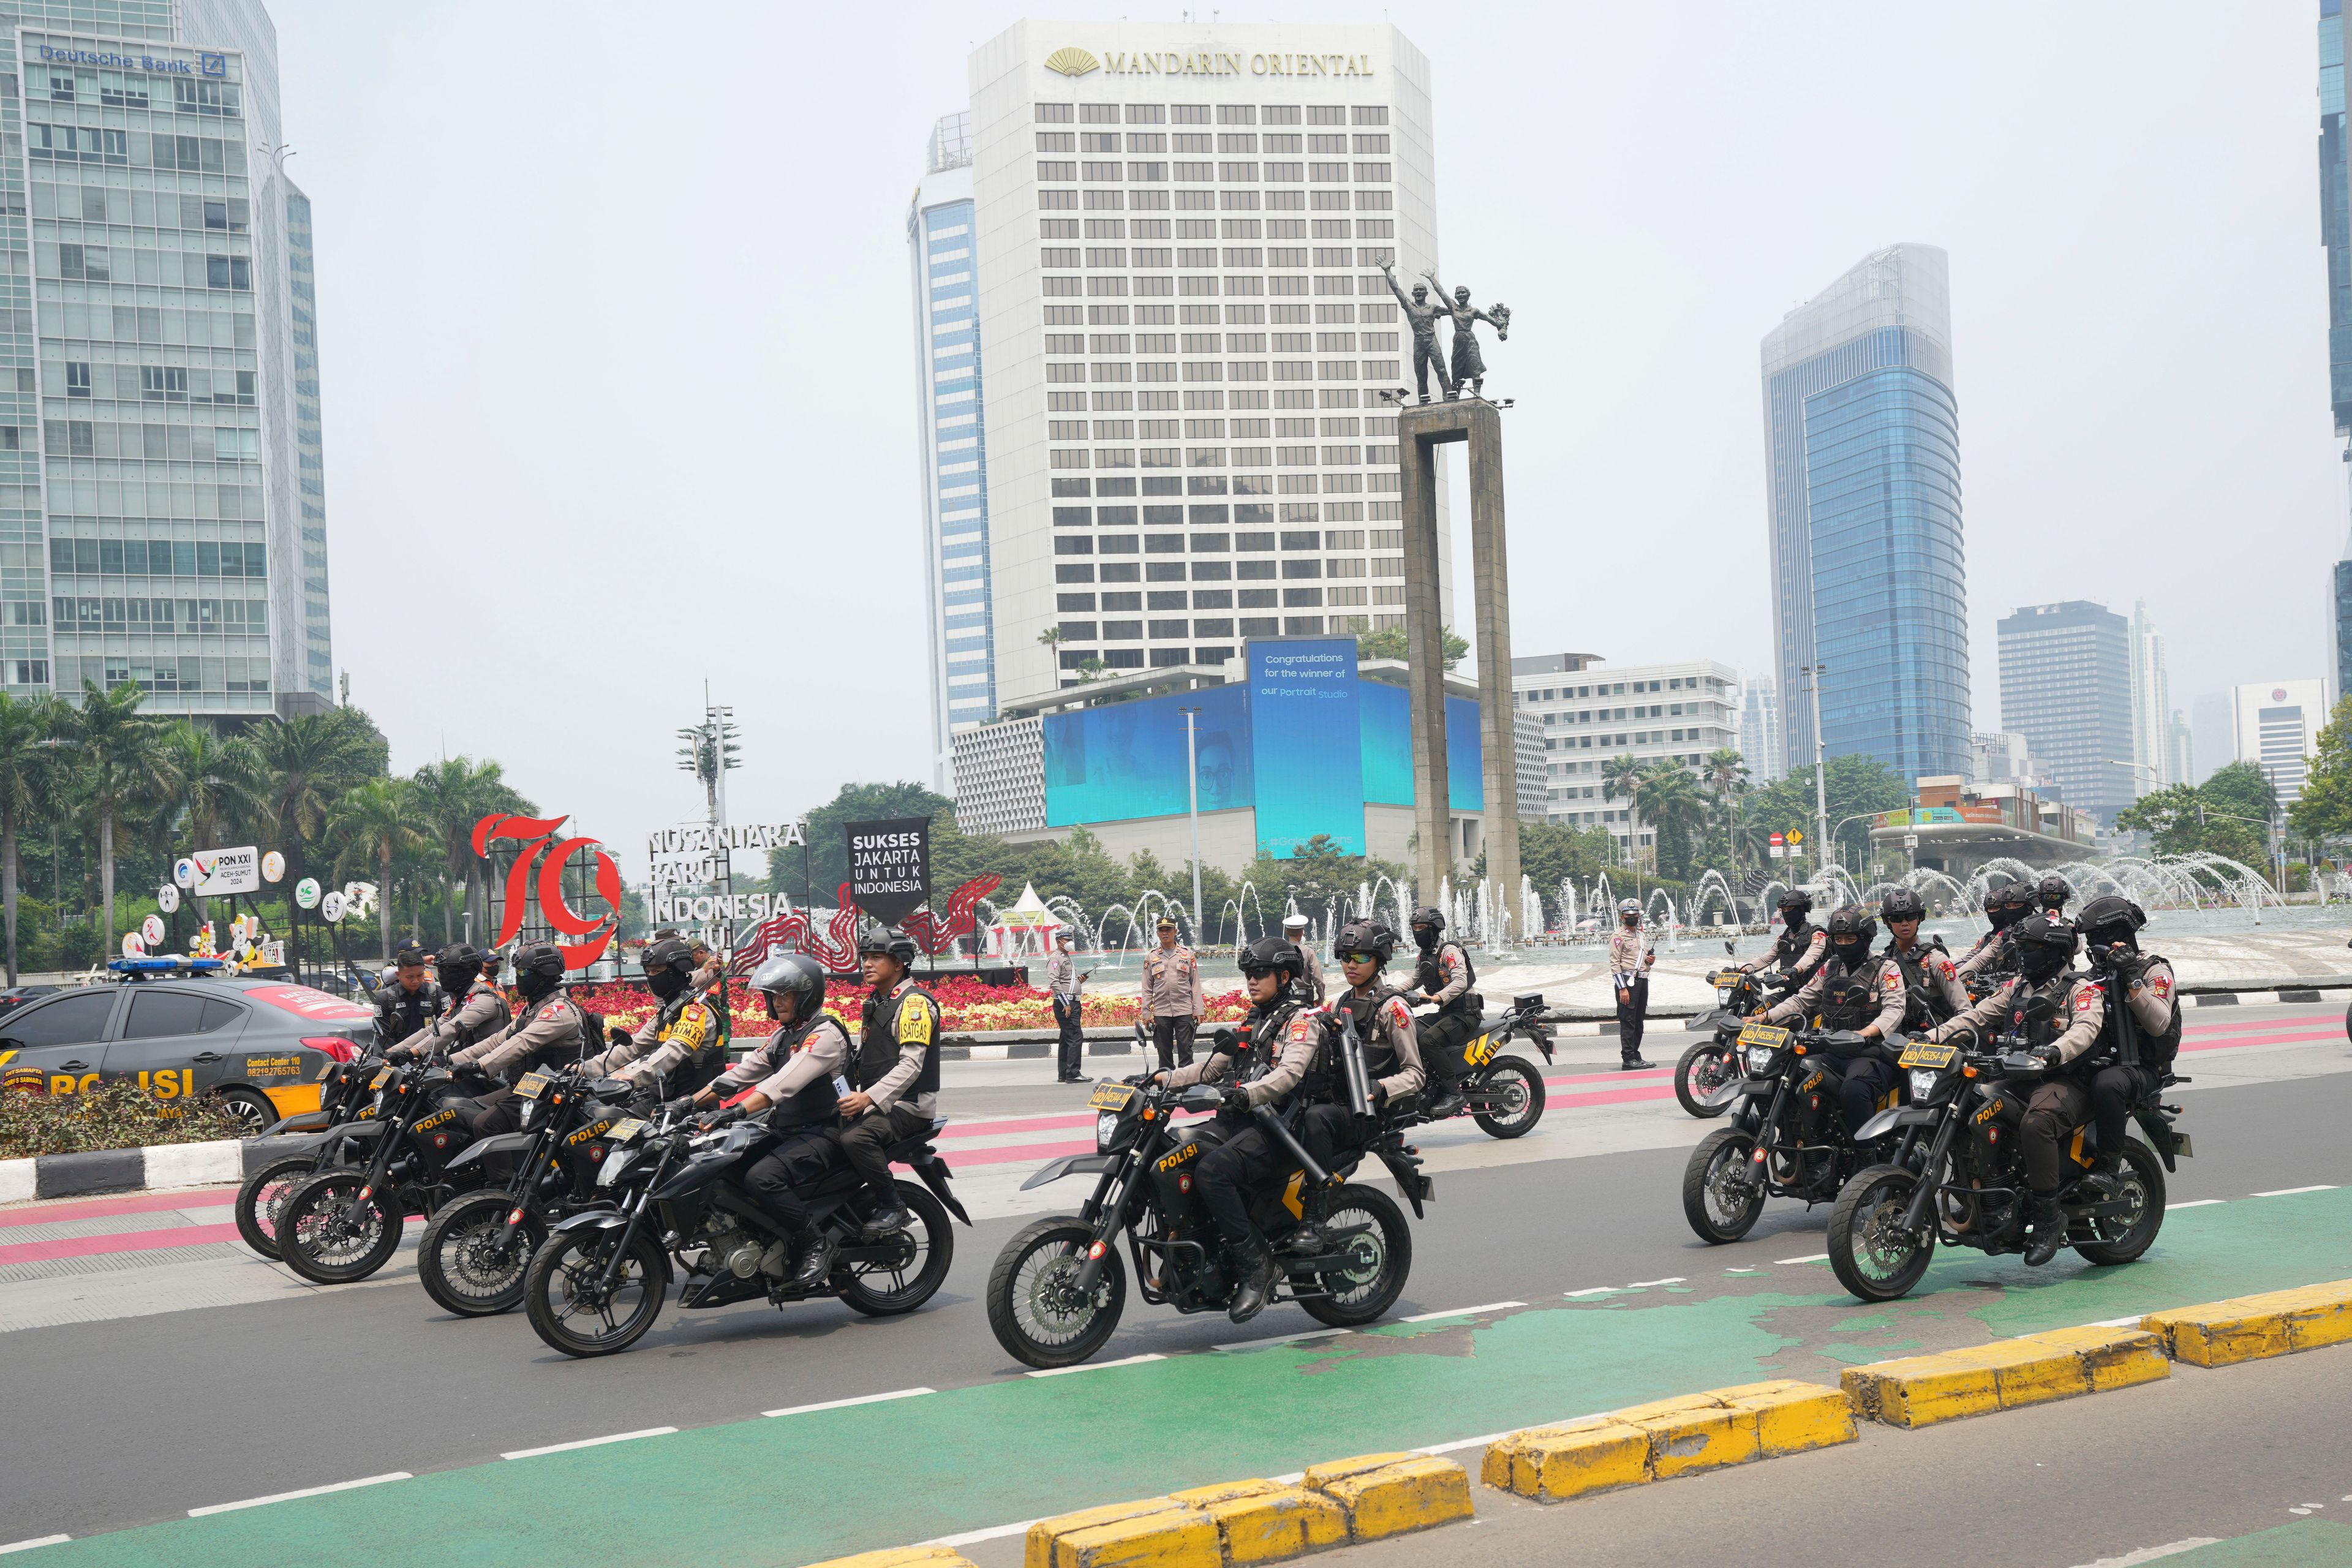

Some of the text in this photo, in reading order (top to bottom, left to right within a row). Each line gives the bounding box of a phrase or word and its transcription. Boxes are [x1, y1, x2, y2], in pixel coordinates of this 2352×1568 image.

[39, 44, 191, 74] Deutsche Bank
[1104, 51, 1375, 76] MANDARIN ORIENTAL
[1265, 653, 1344, 666] Congratulations
[1264, 668, 1346, 679] for the winner of
[1261, 687, 1278, 696] our
[1318, 690, 1348, 699] Studio
[646, 822, 807, 854] NUSANTARA
[853, 832, 920, 850] SUKSES
[219, 854, 251, 866] PON XXI
[854, 849, 921, 867] JAKARTA
[221, 869, 252, 878] ACEH-SUMUT
[647, 858, 718, 886] BARU
[855, 865, 920, 880] UNTUK
[472, 813, 620, 970] 79
[854, 880, 922, 894] INDONESIA
[648, 892, 794, 923] INDONESIA
[1757, 1031, 1784, 1041] 145356-VII
[247, 1056, 300, 1067] Contact Center 110
[1919, 1050, 1951, 1061] 145354-VII
[247, 1066, 300, 1077] 082192765763
[20, 1077, 43, 1085] SABHARA
[1803, 1071, 1823, 1093] POLISI
[415, 1108, 456, 1133] POLISI
[1977, 1098, 2003, 1125] POLISI
[569, 1120, 610, 1146] POLISI
[1159, 1143, 1198, 1172] POLISI
